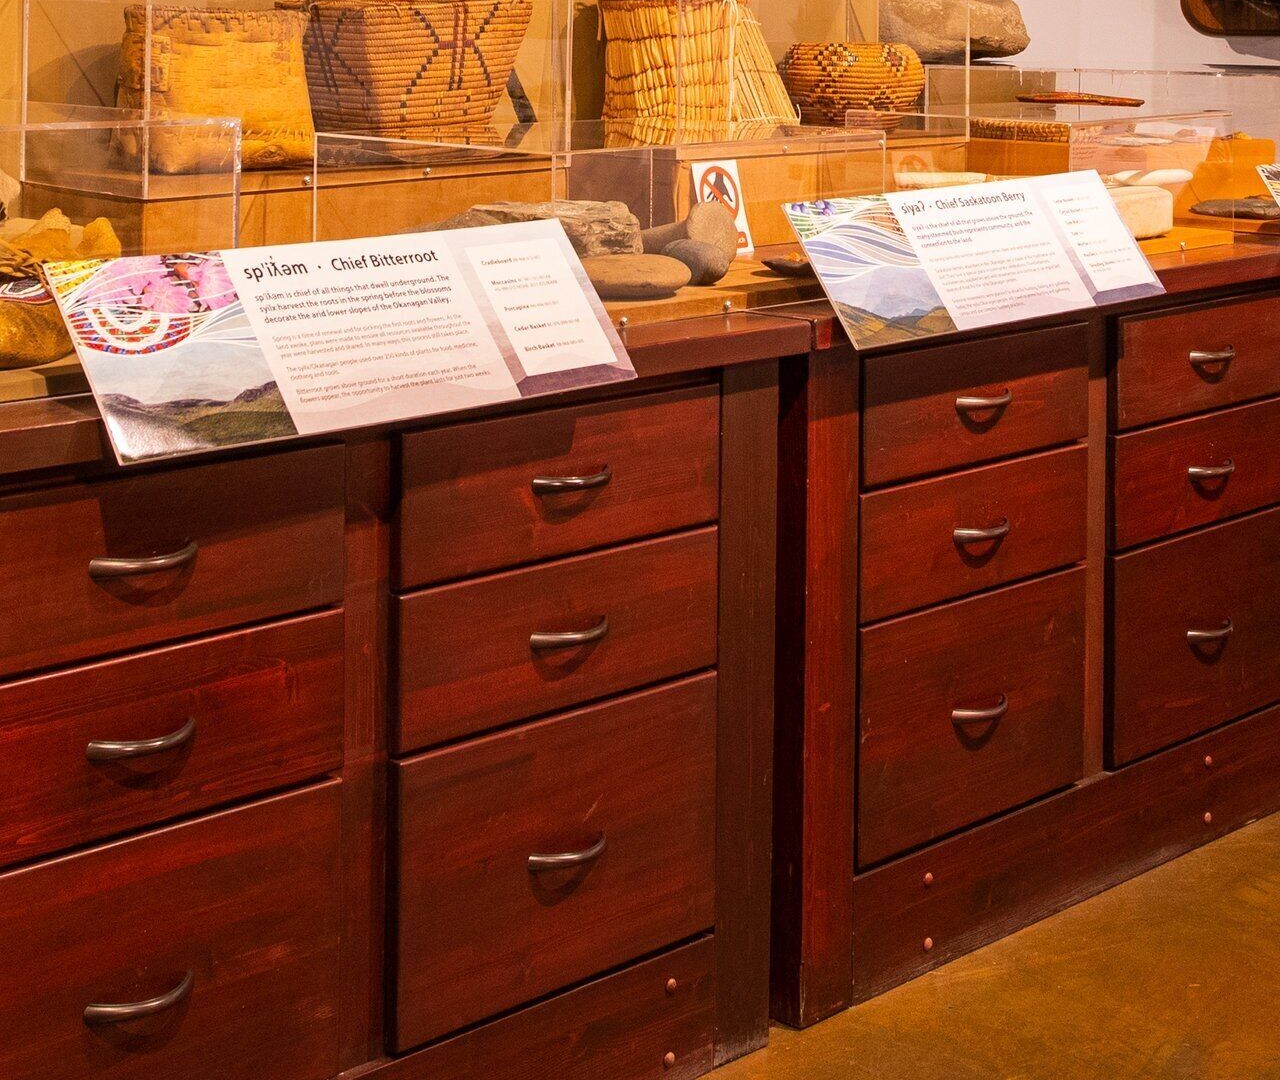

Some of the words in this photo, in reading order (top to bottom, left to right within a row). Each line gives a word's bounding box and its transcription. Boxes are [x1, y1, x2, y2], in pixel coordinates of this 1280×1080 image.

[935, 198, 960, 210] Chief
[958, 195, 1002, 207] Saskatoon
[1001, 193, 1026, 202] Berry
[331, 255, 370, 271] Chief
[370, 249, 438, 267] Bitterroot
[293, 289, 312, 298] chief
[312, 288, 321, 296] of
[331, 285, 354, 293] things
[353, 283, 370, 291] that
[369, 280, 390, 289] dwell
[436, 274, 450, 282] The
[260, 305, 277, 314] syilx
[277, 301, 306, 311] harvest
[306, 300, 319, 308] the
[320, 298, 339, 306] roots
[347, 295, 361, 303] the
[361, 293, 384, 302] spring
[383, 291, 407, 299] before
[407, 288, 420, 296] the
[419, 286, 452, 294] blossoms
[264, 314, 297, 324] decorate
[297, 312, 311, 320] the
[312, 310, 326, 318] arid
[348, 306, 371, 314] slopes
[372, 303, 380, 311] of
[379, 302, 393, 310] the
[393, 300, 428, 308] Okanagan
